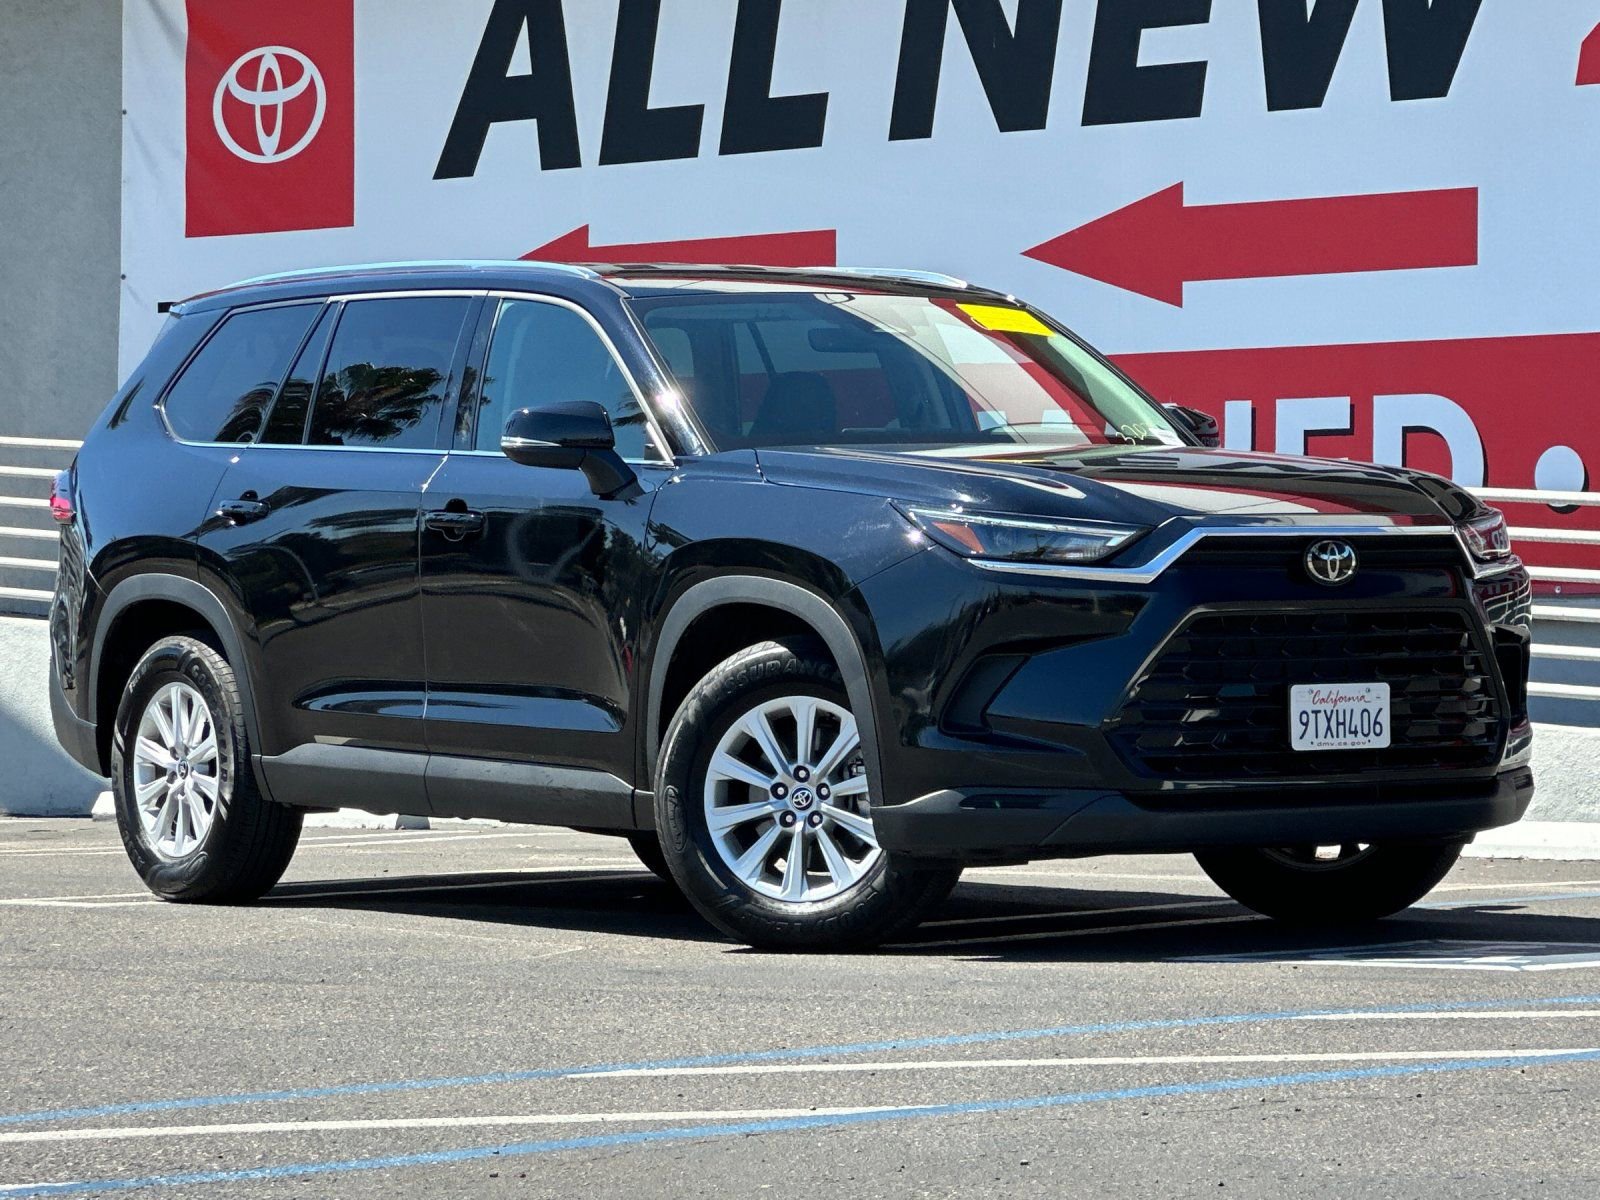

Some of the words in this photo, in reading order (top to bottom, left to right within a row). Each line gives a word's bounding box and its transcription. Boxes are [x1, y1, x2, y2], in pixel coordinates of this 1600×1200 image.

[432, 0, 829, 180] ALL
[1312, 689, 1371, 708] California
[1299, 707, 1383, 739] 9TXH406
